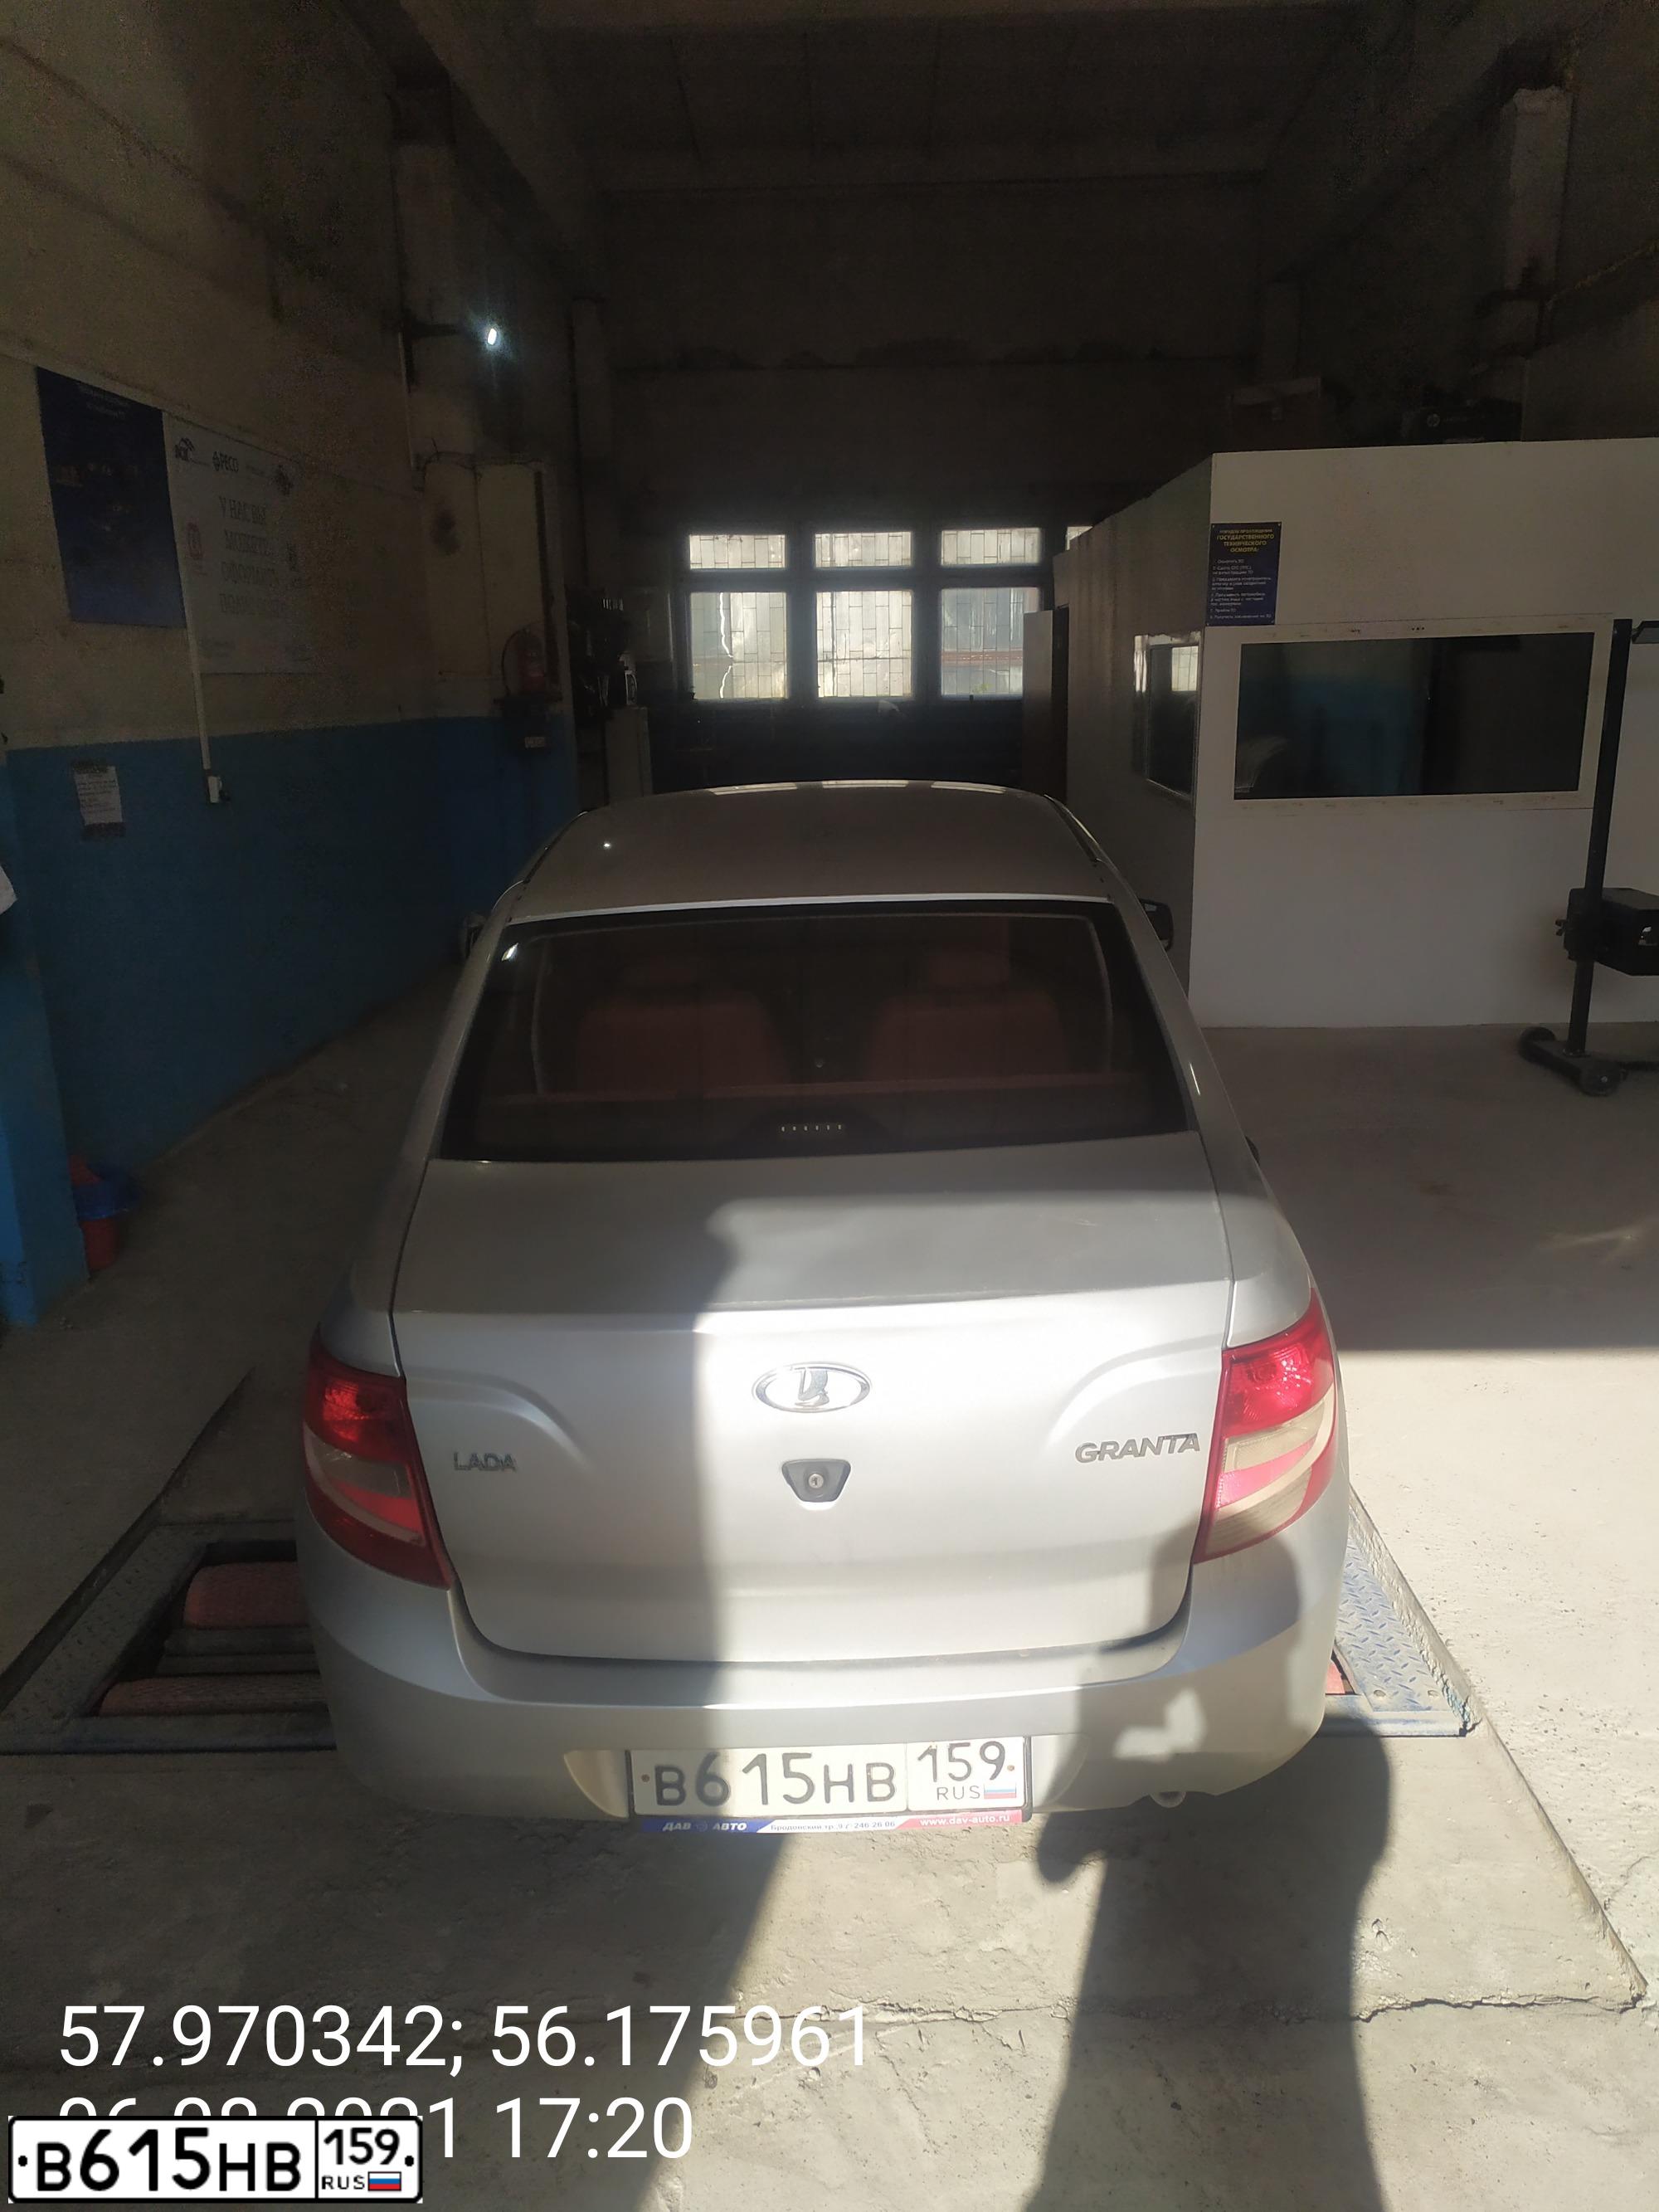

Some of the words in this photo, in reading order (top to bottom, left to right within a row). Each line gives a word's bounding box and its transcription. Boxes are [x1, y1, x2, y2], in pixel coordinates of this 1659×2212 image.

[1075, 1433, 1200, 1464] GRANTA
[453, 1452, 518, 1472] LADA
[917, 1741, 1006, 1782] 159
[936, 1786, 980, 1800] RUS
[713, 1822, 747, 1831] АВТО
[919, 1815, 1010, 1826] www.dav-auto.ru
